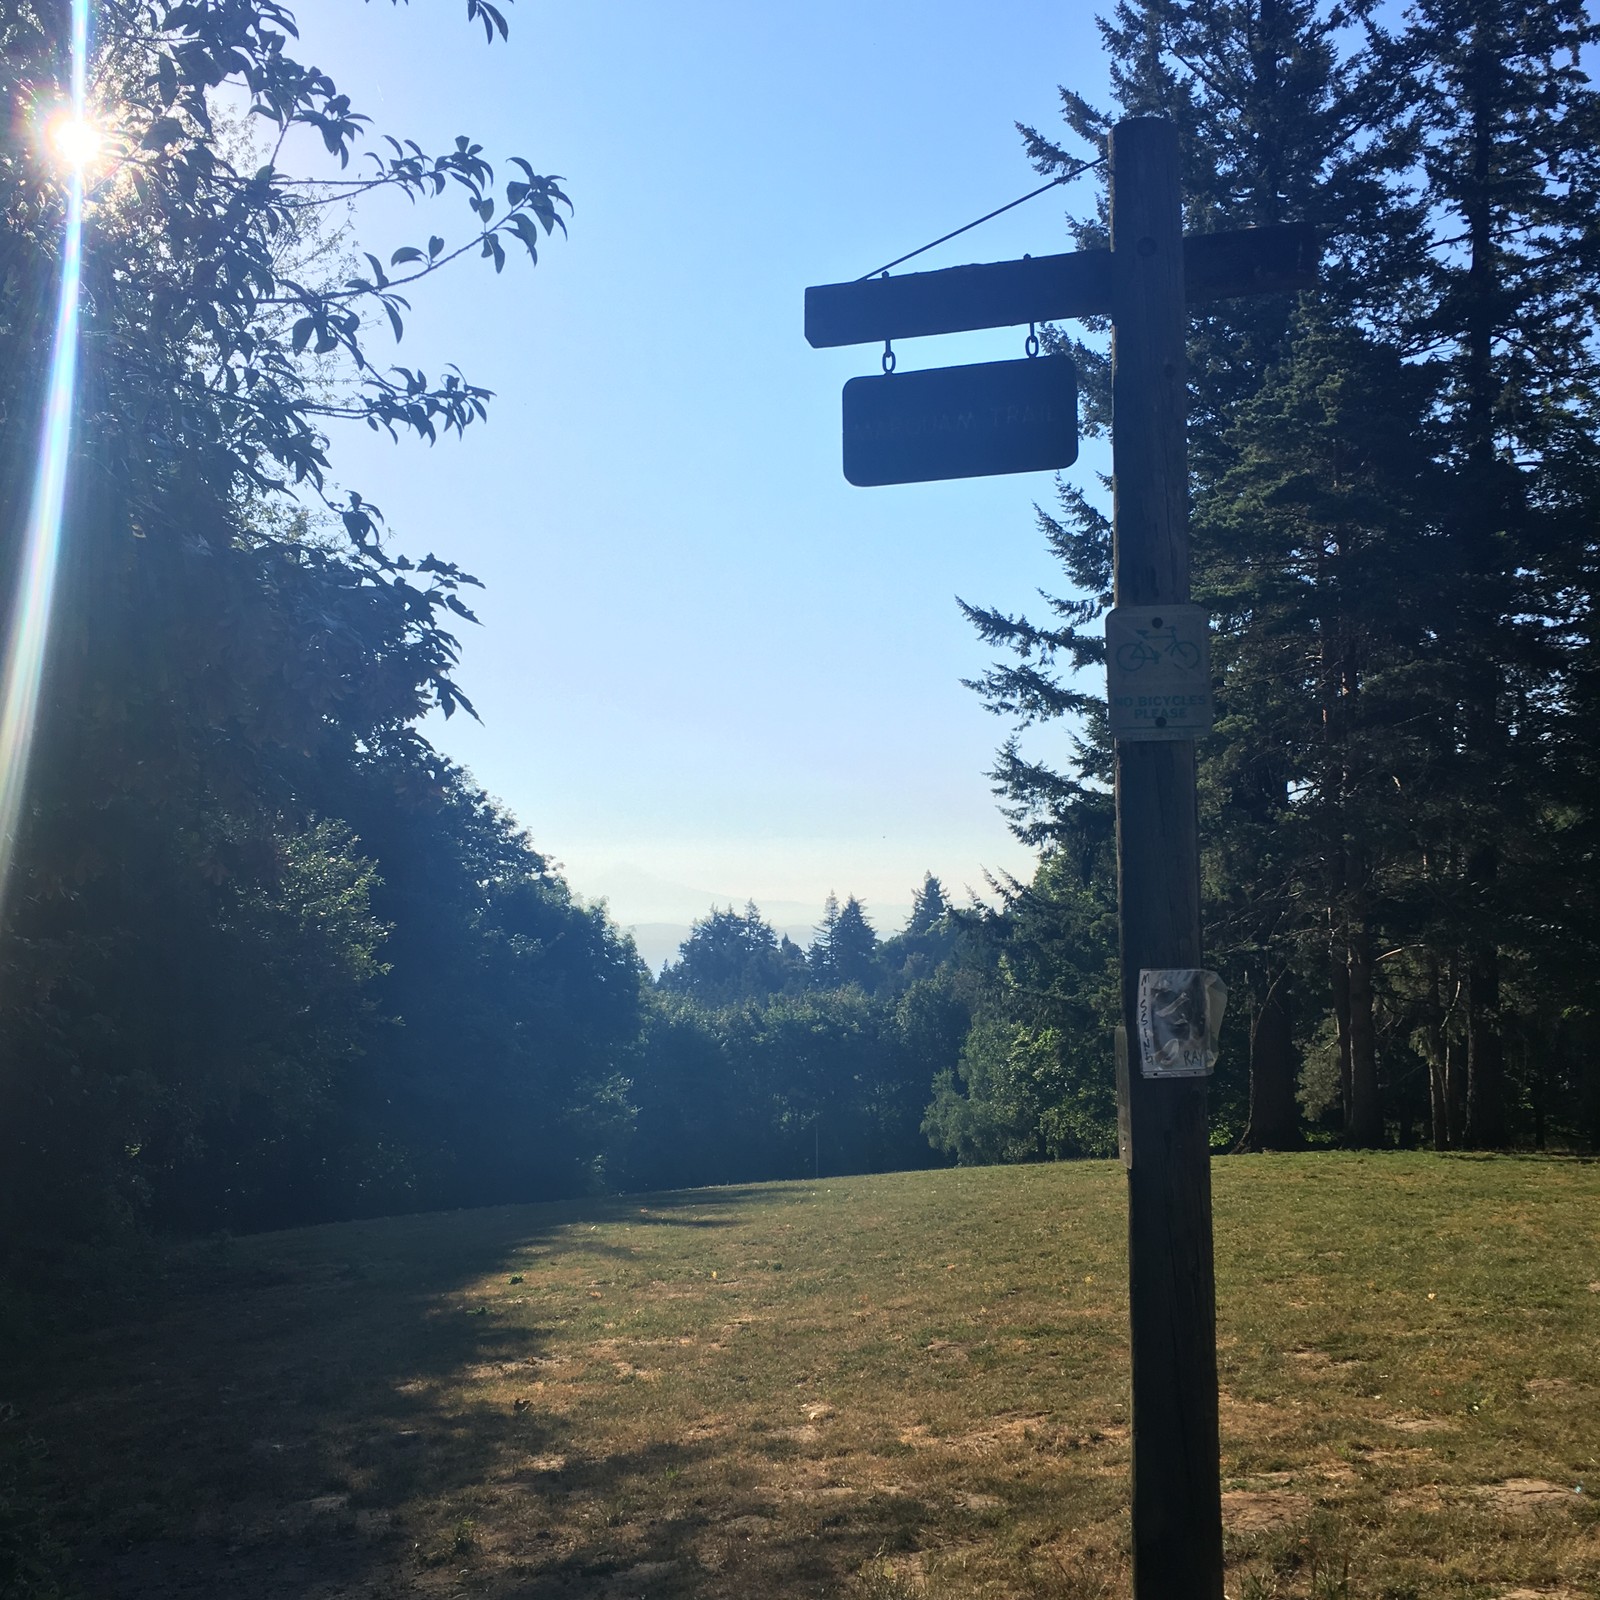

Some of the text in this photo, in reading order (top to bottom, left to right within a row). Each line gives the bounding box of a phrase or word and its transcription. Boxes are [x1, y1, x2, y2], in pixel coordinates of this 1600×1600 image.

[989, 404, 1056, 427] TRAIL
[1114, 695, 1206, 708] NO BICYCLES
[1134, 707, 1188, 719] PLEASE
[1139, 973, 1154, 1065] MISSING
